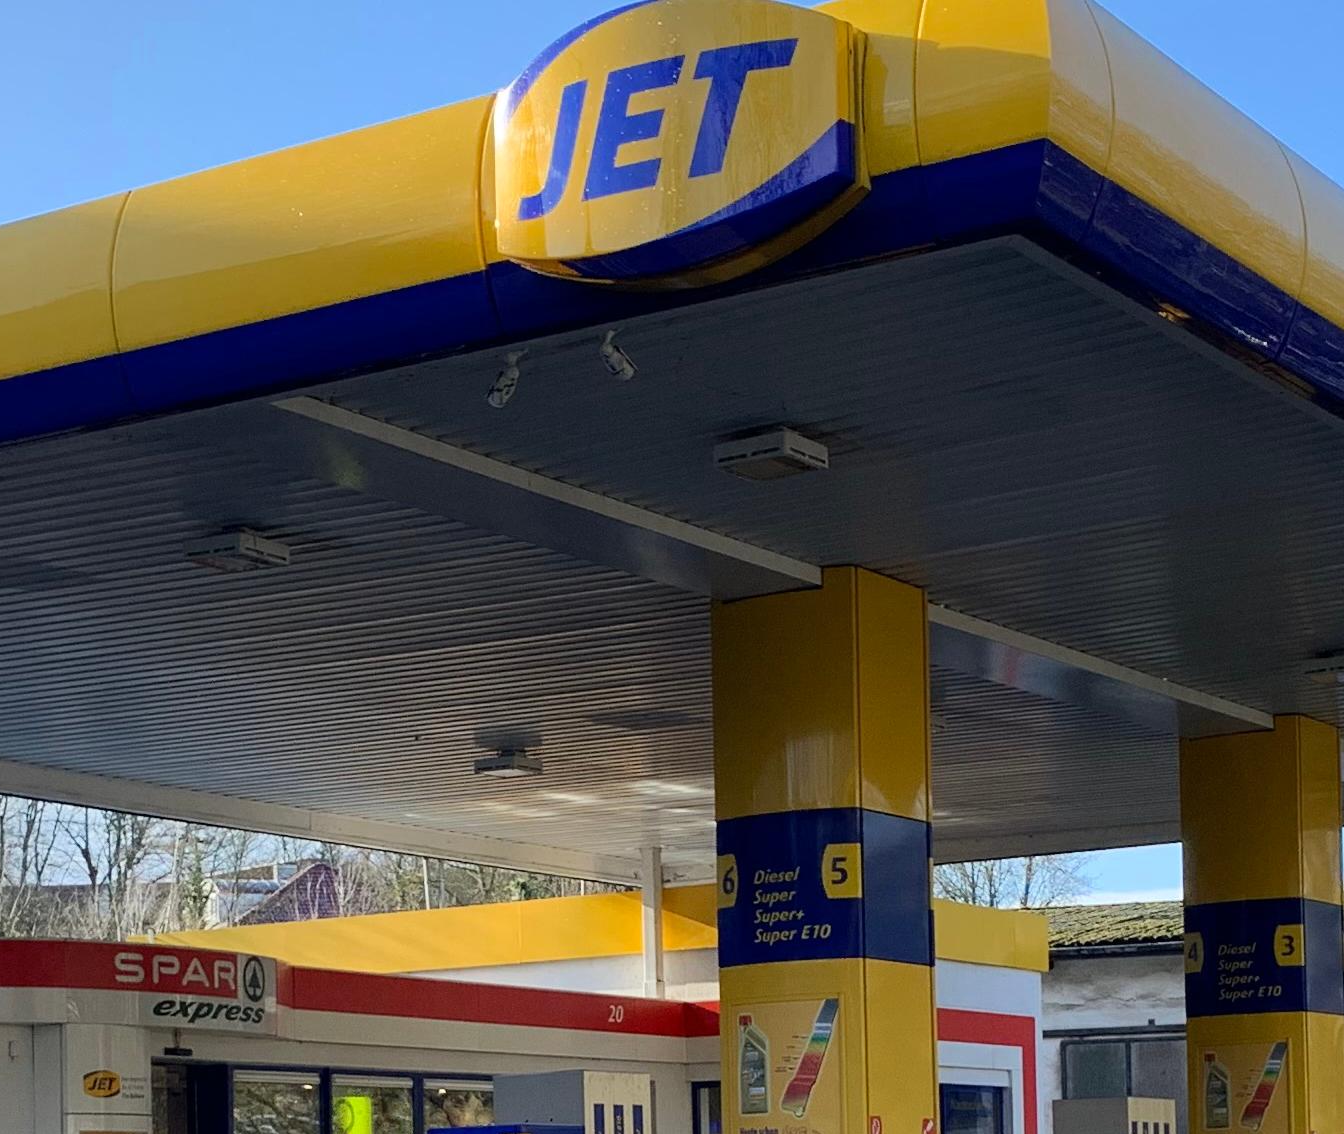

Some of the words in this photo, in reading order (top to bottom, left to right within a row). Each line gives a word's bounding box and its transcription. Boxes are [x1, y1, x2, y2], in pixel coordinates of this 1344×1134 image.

[517, 38, 799, 221] JET
[753, 866, 801, 885] Diesel
[831, 857, 848, 884] 5
[722, 866, 735, 895] 6
[753, 889, 796, 908] Super
[753, 908, 805, 927] Super+
[754, 928, 797, 946] Super
[801, 924, 831, 940] E10
[1218, 942, 1257, 956] Diesel
[1281, 935, 1295, 956] 3
[114, 952, 236, 990] SPAR
[1218, 960, 1253, 973] Super
[1218, 989, 1255, 1002] Super
[1257, 985, 1282, 997] E10
[152, 999, 265, 1023] express
[608, 1005, 624, 1023] 20
[87, 1076, 117, 1091] JET
